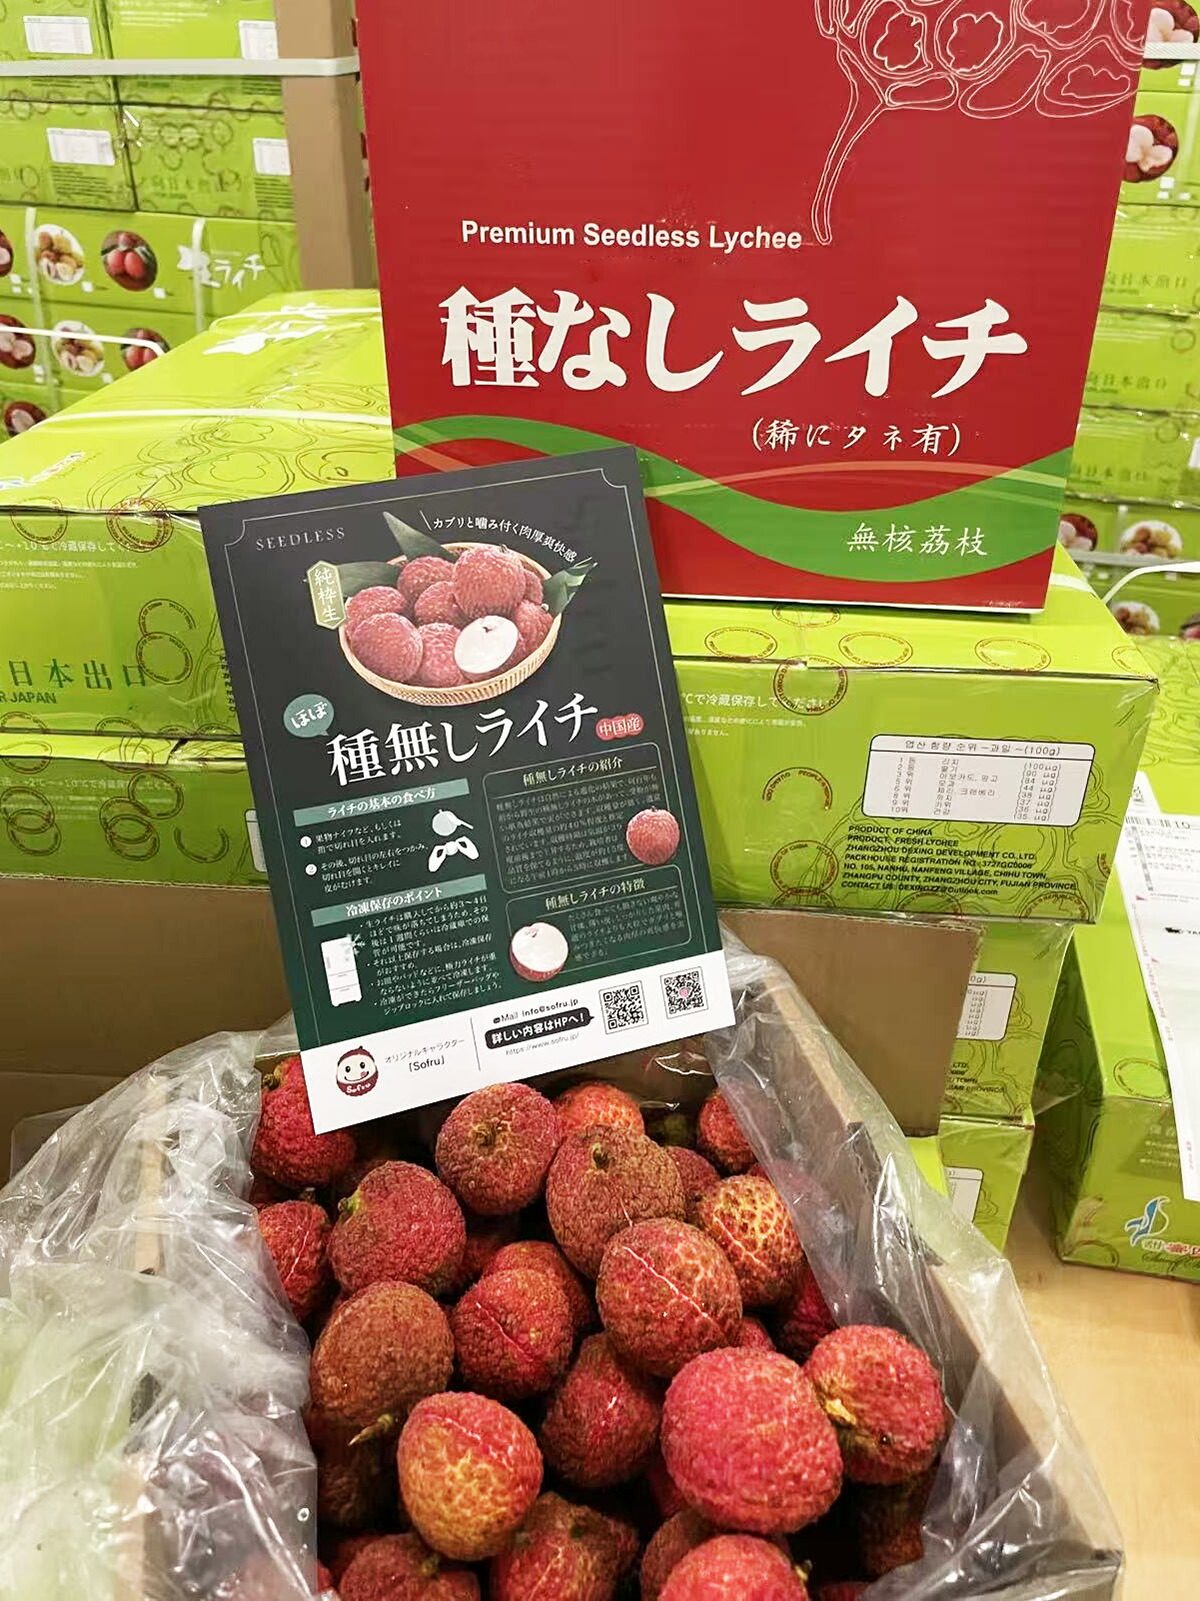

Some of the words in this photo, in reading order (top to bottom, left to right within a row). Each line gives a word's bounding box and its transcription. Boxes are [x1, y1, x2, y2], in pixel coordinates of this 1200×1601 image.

[462, 220, 575, 248] Premium
[583, 222, 700, 249] Seedless
[709, 224, 802, 251] Lychee
[438, 284, 1029, 399] 種なしライチ
[255, 526, 346, 552] SEEDLESS
[846, 522, 988, 557] 無核荔枝
[10, 691, 58, 704] JAPAN
[290, 701, 331, 729] ほぼ
[599, 715, 642, 735] 中国産
[326, 693, 599, 787] 種無しライチ
[327, 786, 436, 818] ライチの基本の食べ方
[848, 825, 891, 834] PRODUCT
[345, 885, 443, 916] 冷凍保存のポイント
[522, 998, 579, 1018] info@sofru.jp
[384, 1038, 466, 1064] オリジナルキャラクター
